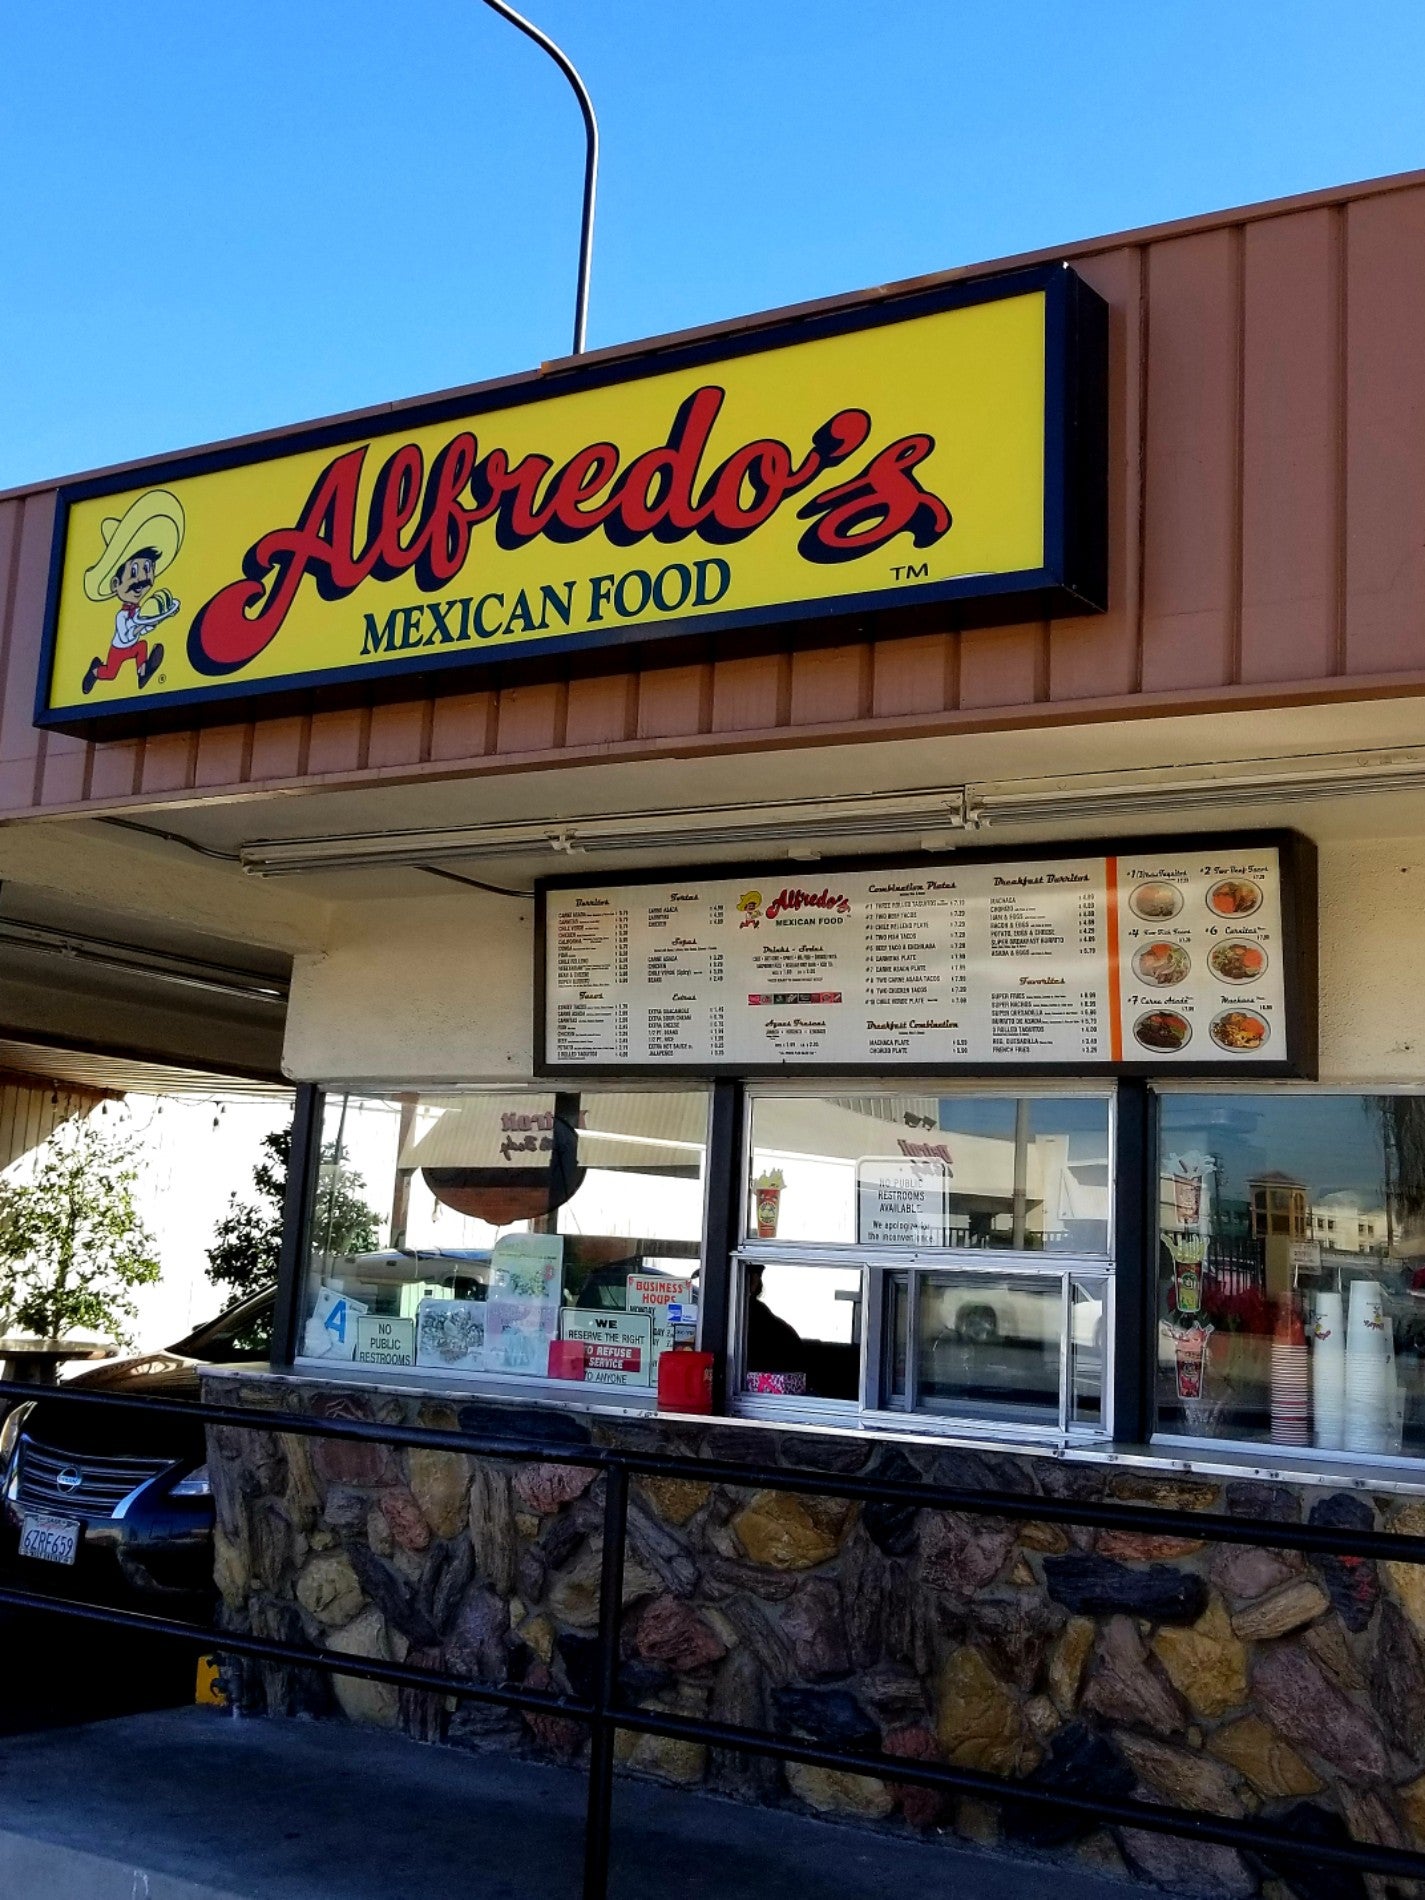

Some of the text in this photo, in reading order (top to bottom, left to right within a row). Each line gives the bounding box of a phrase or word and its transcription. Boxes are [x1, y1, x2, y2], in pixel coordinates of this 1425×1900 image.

[186, 385, 953, 677] Alfredo's
[890, 563, 930, 581] TM
[360, 557, 732, 655] MEXICAN FOOD
[993, 873, 1090, 887] Breakfast Burritos
[869, 880, 957, 893] Combination Plates
[765, 888, 851, 919] Alfredo's
[775, 917, 844, 927] MEXICAN FOOD
[1019, 976, 1066, 986] Favorites
[579, 991, 604, 1000] Tacos
[866, 1019, 959, 1031] Breakfast Combination
[879, 1178, 891, 1188] NO
[878, 1191, 925, 1201] RESTROOMS
[879, 1203, 923, 1213] AVAILABLE
[872, 1220, 883, 1229] We
[885, 1222, 918, 1232] apologize
[868, 1232, 879, 1240] the
[636, 1281, 683, 1294] BUSINESS
[642, 1293, 676, 1305] HOURS
[324, 1299, 347, 1344] A
[594, 1319, 618, 1329] WE
[378, 1324, 392, 1335] NO
[370, 1337, 401, 1350] PUBLIC
[568, 1330, 646, 1345] RESERVE THE RIGHT
[359, 1351, 411, 1366] RESTROOMS
[596, 1347, 632, 1358] REFUSE
[589, 1357, 624, 1369] SERVICE
[595, 1374, 628, 1384] ANYONE
[24, 1529, 74, 1557] 6ZRF659
